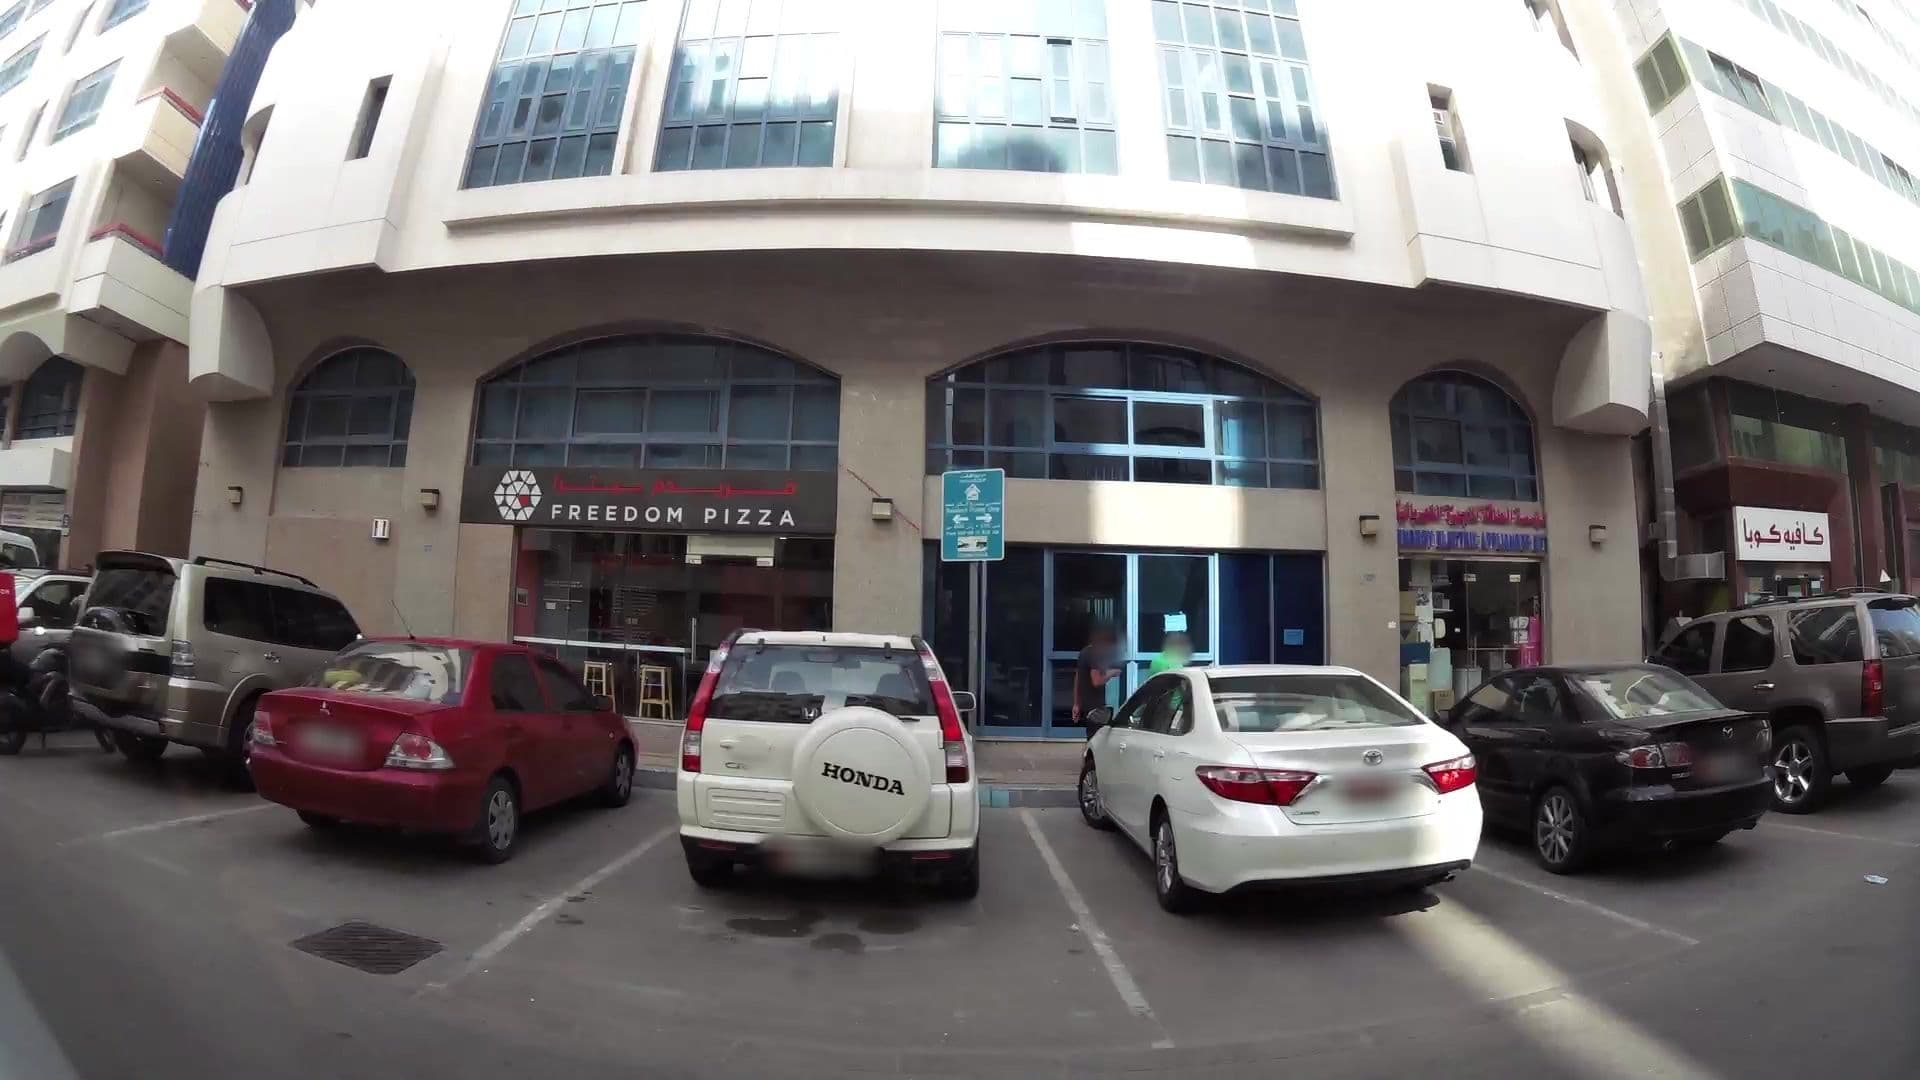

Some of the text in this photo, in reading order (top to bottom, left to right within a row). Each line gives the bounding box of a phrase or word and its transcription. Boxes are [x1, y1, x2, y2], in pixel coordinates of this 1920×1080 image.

[551, 504, 796, 527] FREEDOM PIZZA
[1743, 517, 1825, 551] كافيه كوبا
[821, 761, 905, 796] HONDA
